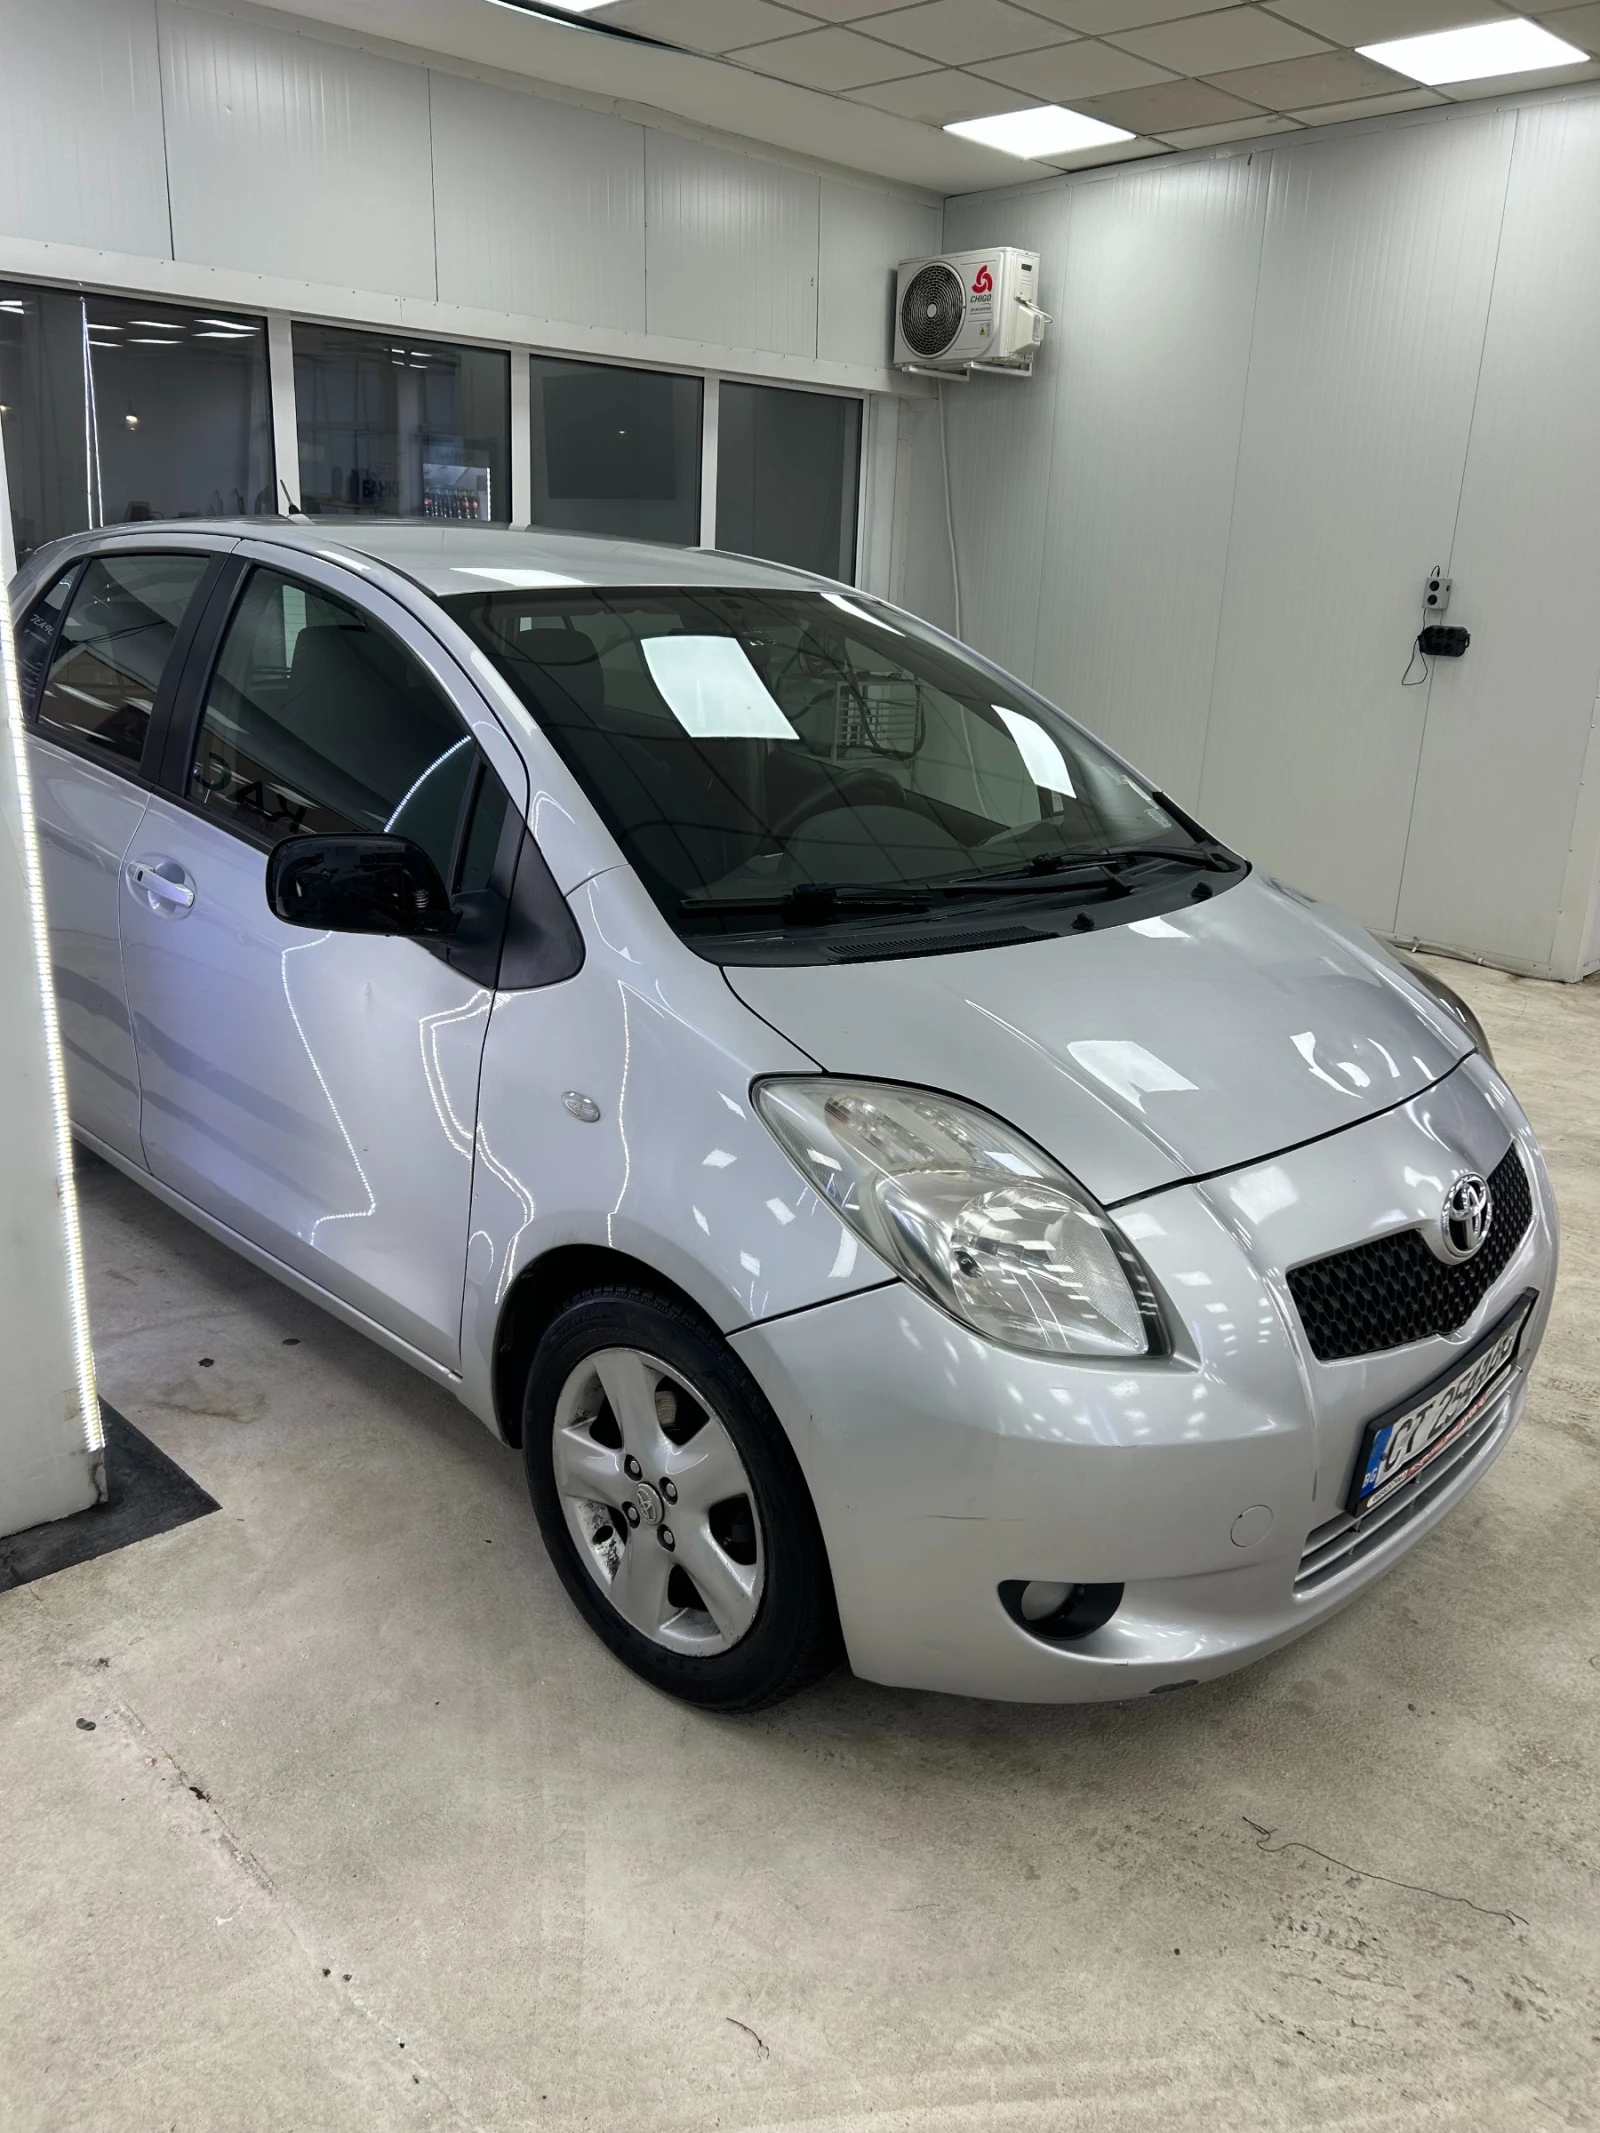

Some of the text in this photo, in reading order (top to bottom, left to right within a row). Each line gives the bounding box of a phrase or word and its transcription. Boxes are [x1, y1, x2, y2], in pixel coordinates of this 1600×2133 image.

[970, 293, 992, 304] CHIGO
[1384, 1404, 1433, 1473] CT
[1362, 1466, 1378, 1489] BG
